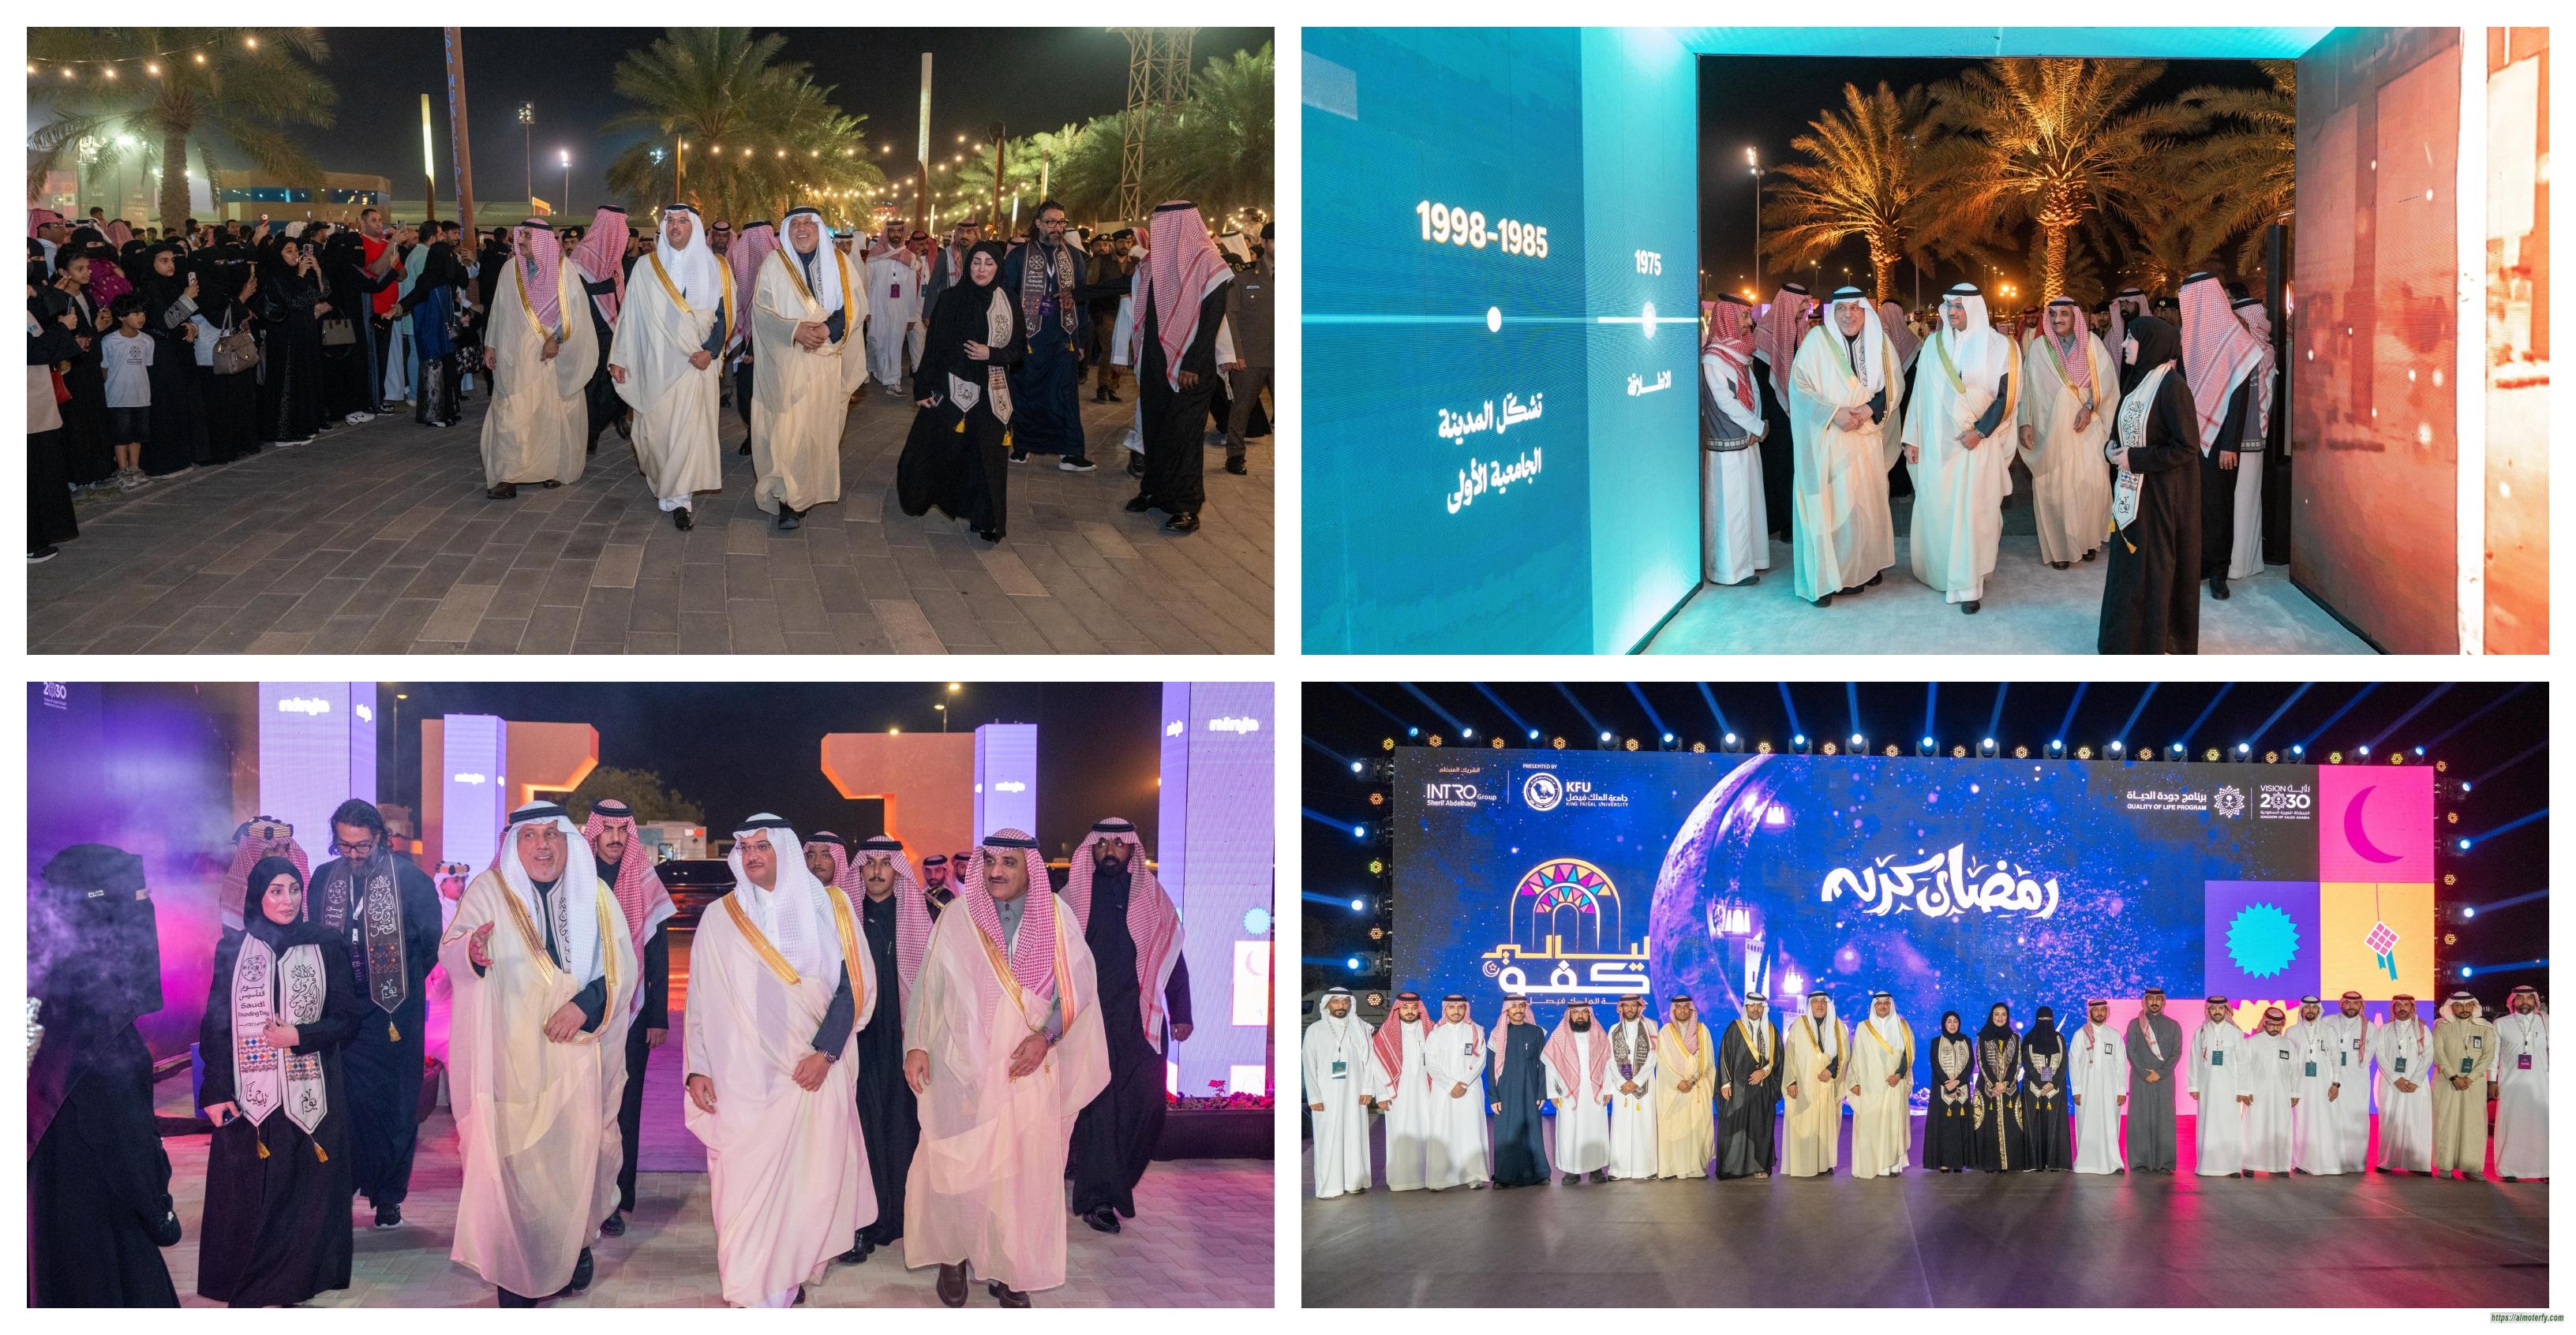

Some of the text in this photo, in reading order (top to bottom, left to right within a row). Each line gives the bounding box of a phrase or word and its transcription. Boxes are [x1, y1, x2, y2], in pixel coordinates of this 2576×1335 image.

[1417, 200, 1548, 259] 1998-1985
[1634, 249, 1661, 276] 1975
[1438, 399, 1493, 444] المدينة
[1447, 447, 1541, 514] الجامعية الأولى
[1427, 783, 1477, 799] INTRO
[1566, 782, 1591, 792] KFU
[2157, 792, 2179, 802] جودة
[2181, 791, 2207, 802] برنامج
[1916, 843, 2059, 919] رمضان
